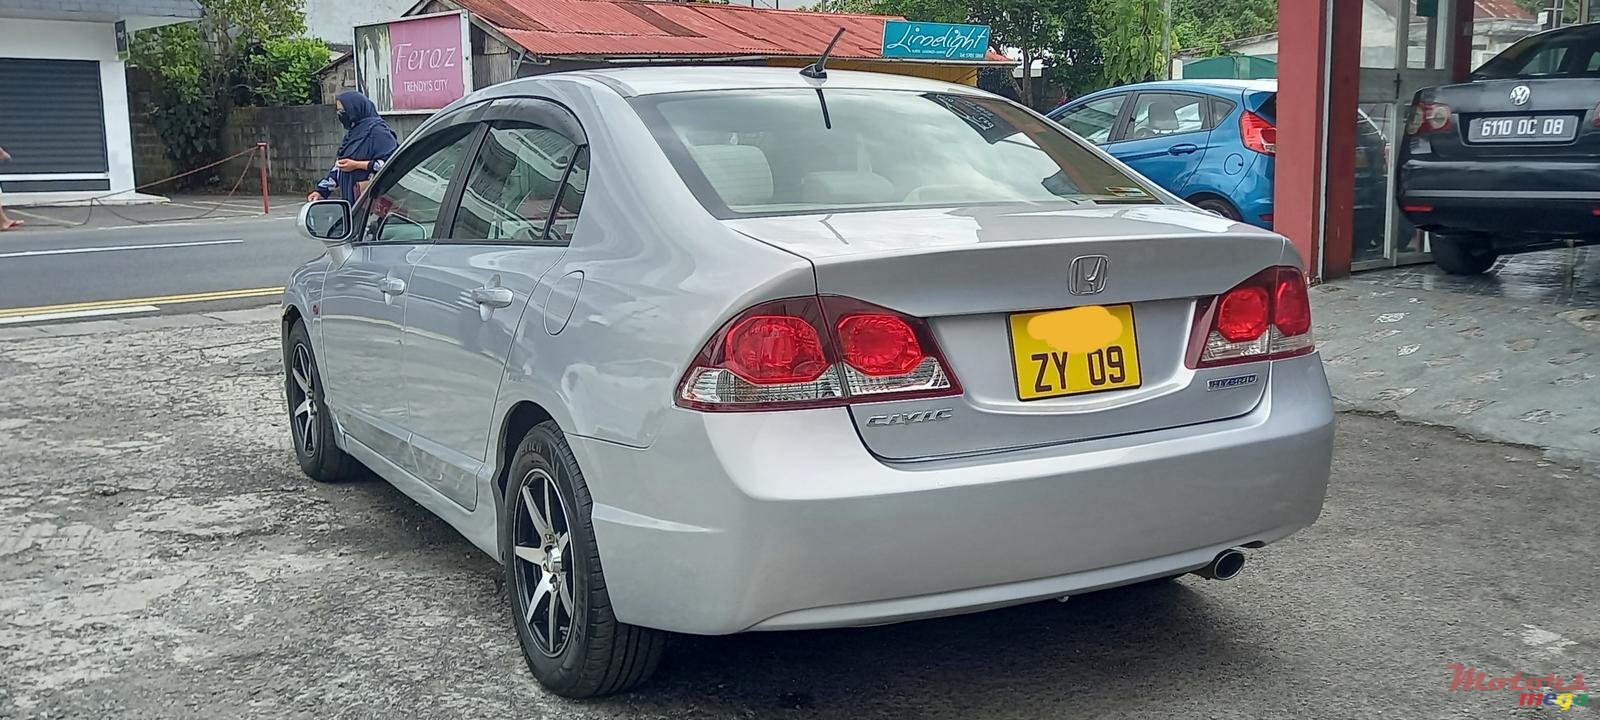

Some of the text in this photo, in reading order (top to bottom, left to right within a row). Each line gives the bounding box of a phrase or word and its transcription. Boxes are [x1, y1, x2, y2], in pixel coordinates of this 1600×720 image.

[887, 24, 987, 58] Limelight
[391, 43, 457, 75] Feroz
[403, 79, 449, 93] TRENDY'S CITY
[1481, 120, 1512, 136] 6110
[1542, 118, 1564, 135] 08
[1031, 345, 1126, 393] ZY 09
[1208, 374, 1258, 390] HYBRID
[866, 408, 953, 427] CIVIC
